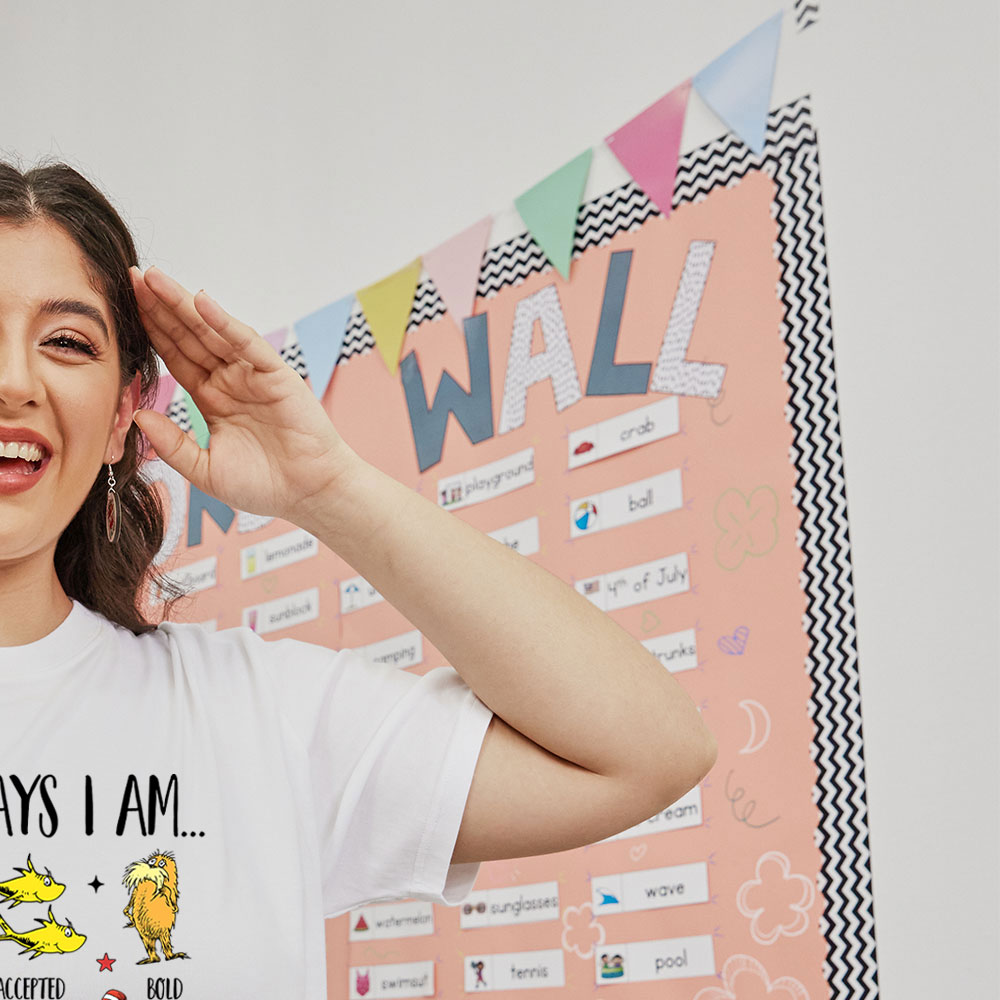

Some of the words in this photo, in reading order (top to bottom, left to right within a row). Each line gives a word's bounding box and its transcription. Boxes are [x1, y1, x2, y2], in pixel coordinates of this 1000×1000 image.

[400, 240, 727, 473] WALL
[619, 417, 656, 442] crab
[627, 488, 654, 513] ball
[656, 563, 688, 587] July
[85, 775, 93, 836] I
[116, 774, 205, 837] AM...
[644, 881, 686, 899] wave
[489, 892, 558, 918] sunglasses
[510, 964, 549, 980] tennis
[654, 947, 689, 974] pool
[148, 978, 183, 1000] BOLD
